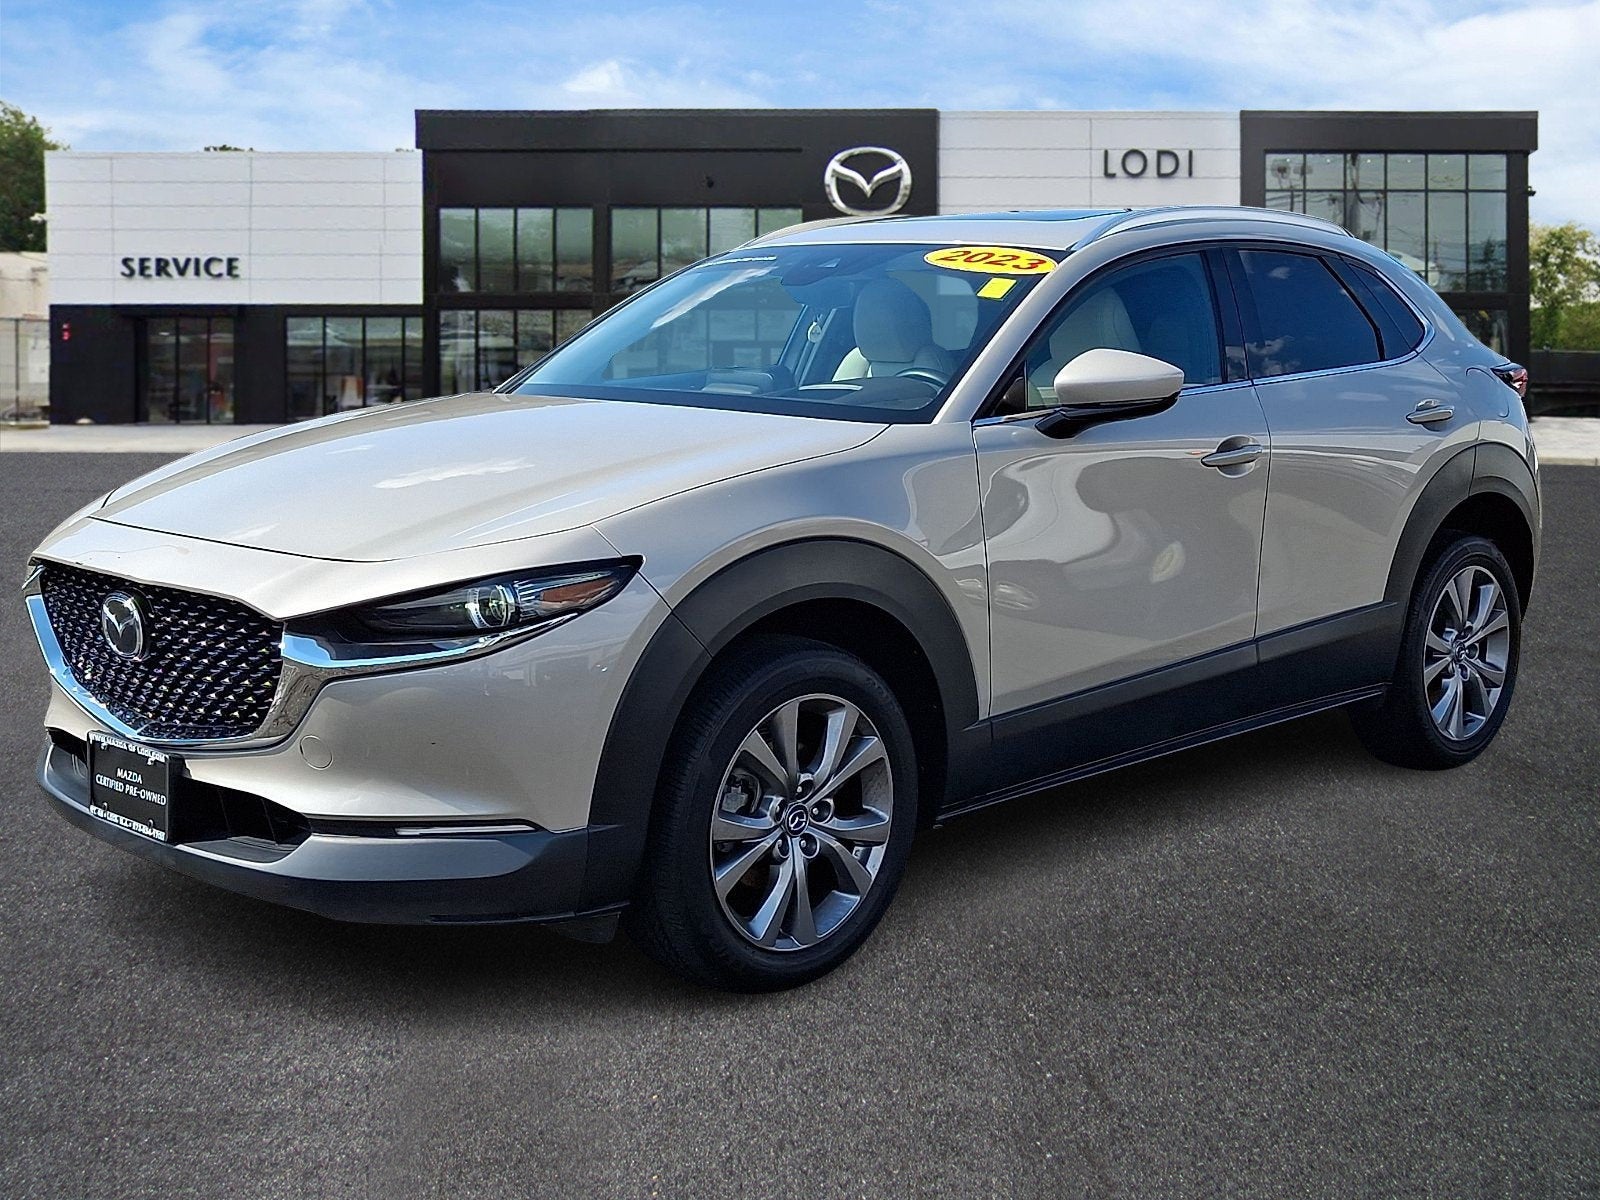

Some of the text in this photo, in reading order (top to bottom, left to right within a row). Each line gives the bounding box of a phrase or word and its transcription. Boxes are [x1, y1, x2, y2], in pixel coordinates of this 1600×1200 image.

[1103, 149, 1194, 178] LODI
[120, 256, 240, 279] SERVICE
[937, 250, 1047, 270] 2023
[116, 768, 142, 784] MAZDA
[95, 774, 166, 805] CERTIFIED PRE-OWNED
